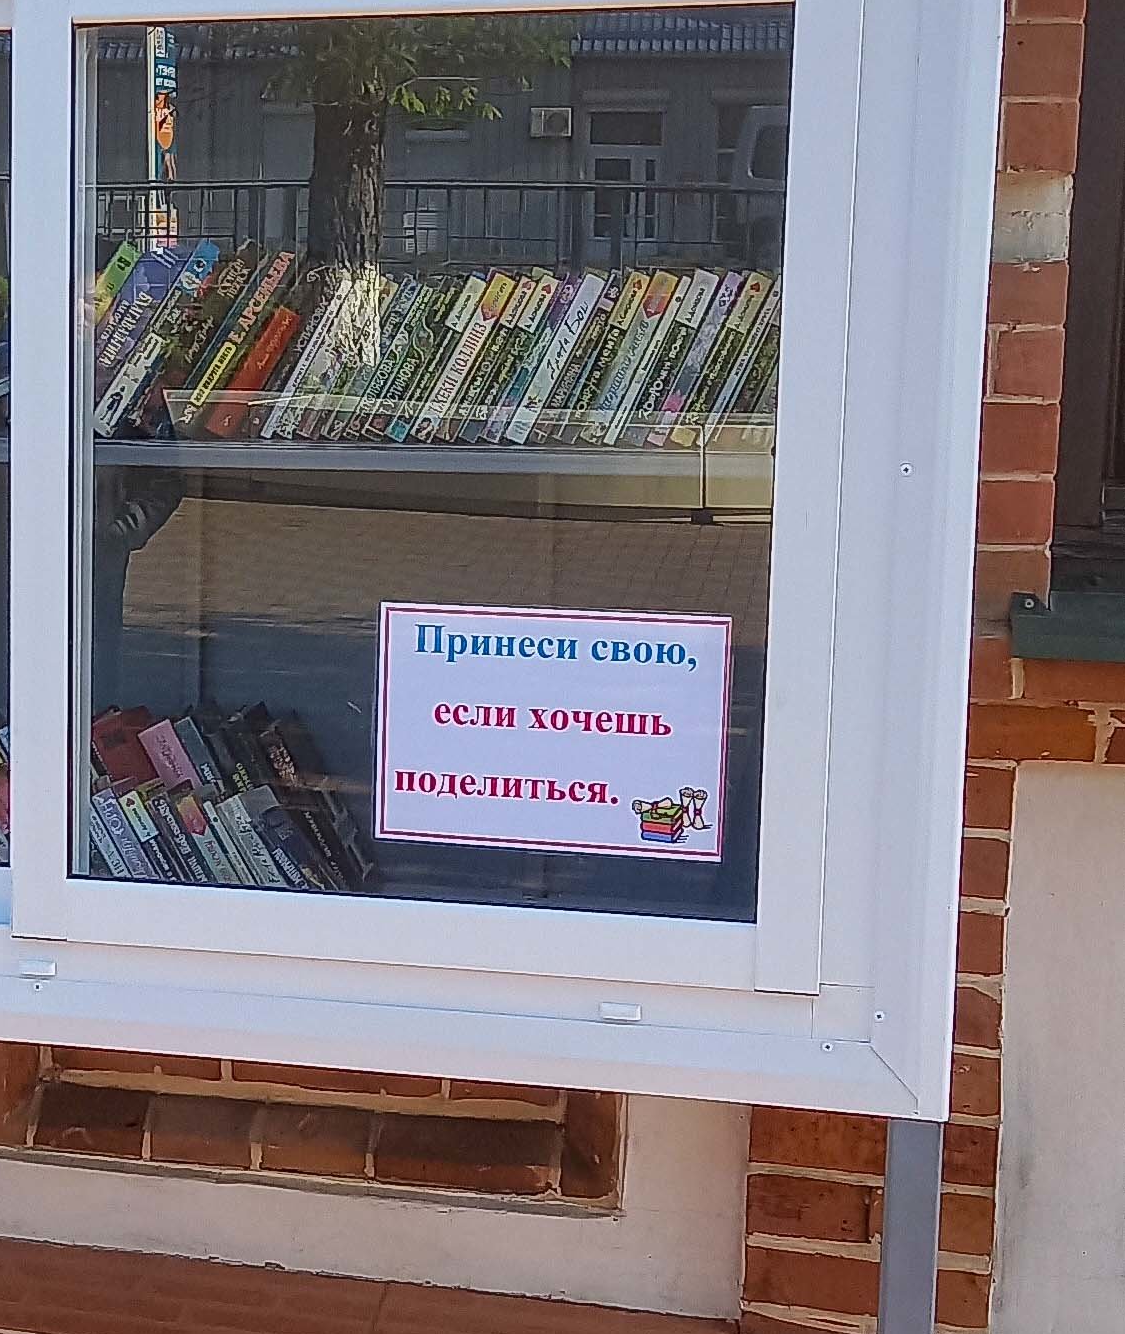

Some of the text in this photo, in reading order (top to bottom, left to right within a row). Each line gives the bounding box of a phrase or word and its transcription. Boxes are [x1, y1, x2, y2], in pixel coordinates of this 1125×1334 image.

[236, 245, 297, 332] АРСЕНЬЕВА
[382, 353, 420, 409] УСТИНОВА
[415, 624, 697, 672] Принеси свою,
[434, 703, 673, 736] если хочешь
[395, 770, 619, 805] поделиться.
